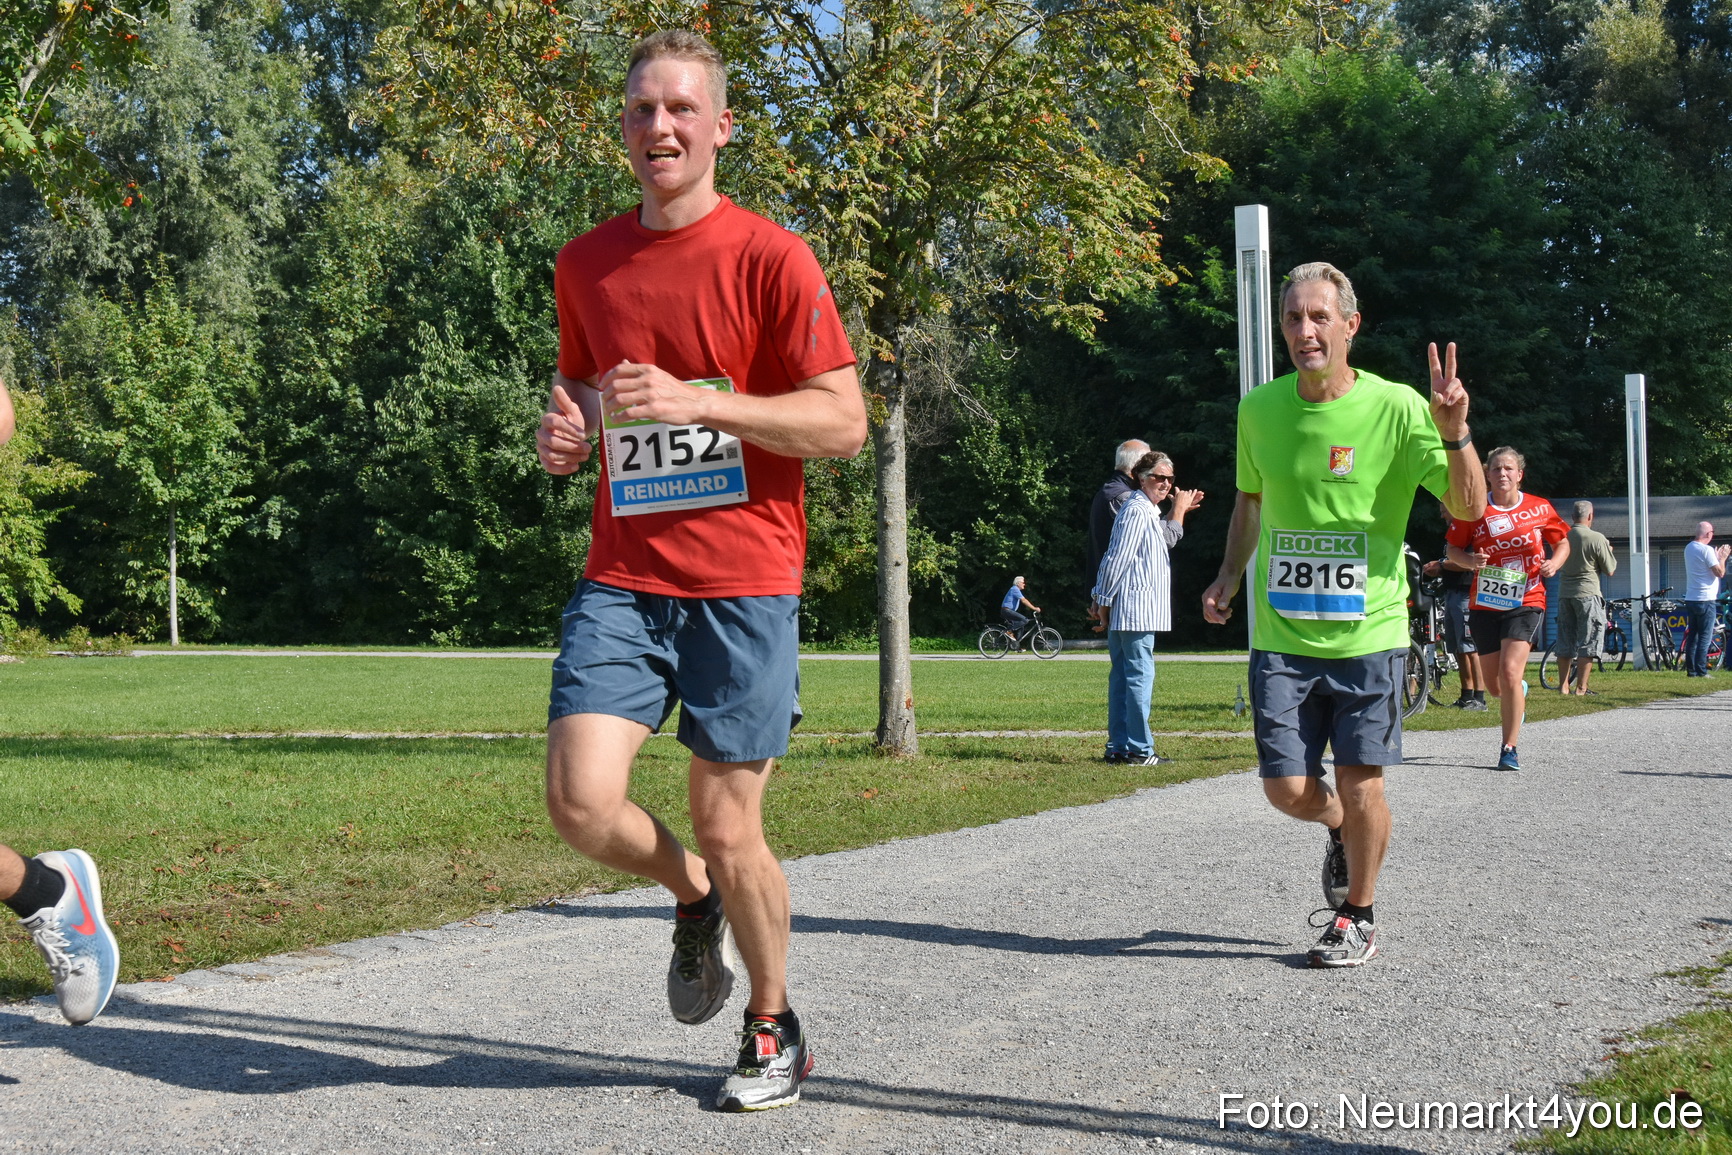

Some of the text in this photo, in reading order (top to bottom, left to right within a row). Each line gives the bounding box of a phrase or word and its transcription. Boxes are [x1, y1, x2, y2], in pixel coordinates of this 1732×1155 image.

[619, 427, 724, 472] 2152
[623, 474, 728, 501] REINHARD
[1277, 533, 1358, 556] BOCK
[1277, 561, 1355, 590] 2816
[1483, 566, 1523, 583] BOCK
[1482, 580, 1518, 598] 2261
[1484, 596, 1513, 607] CLAUDIA
